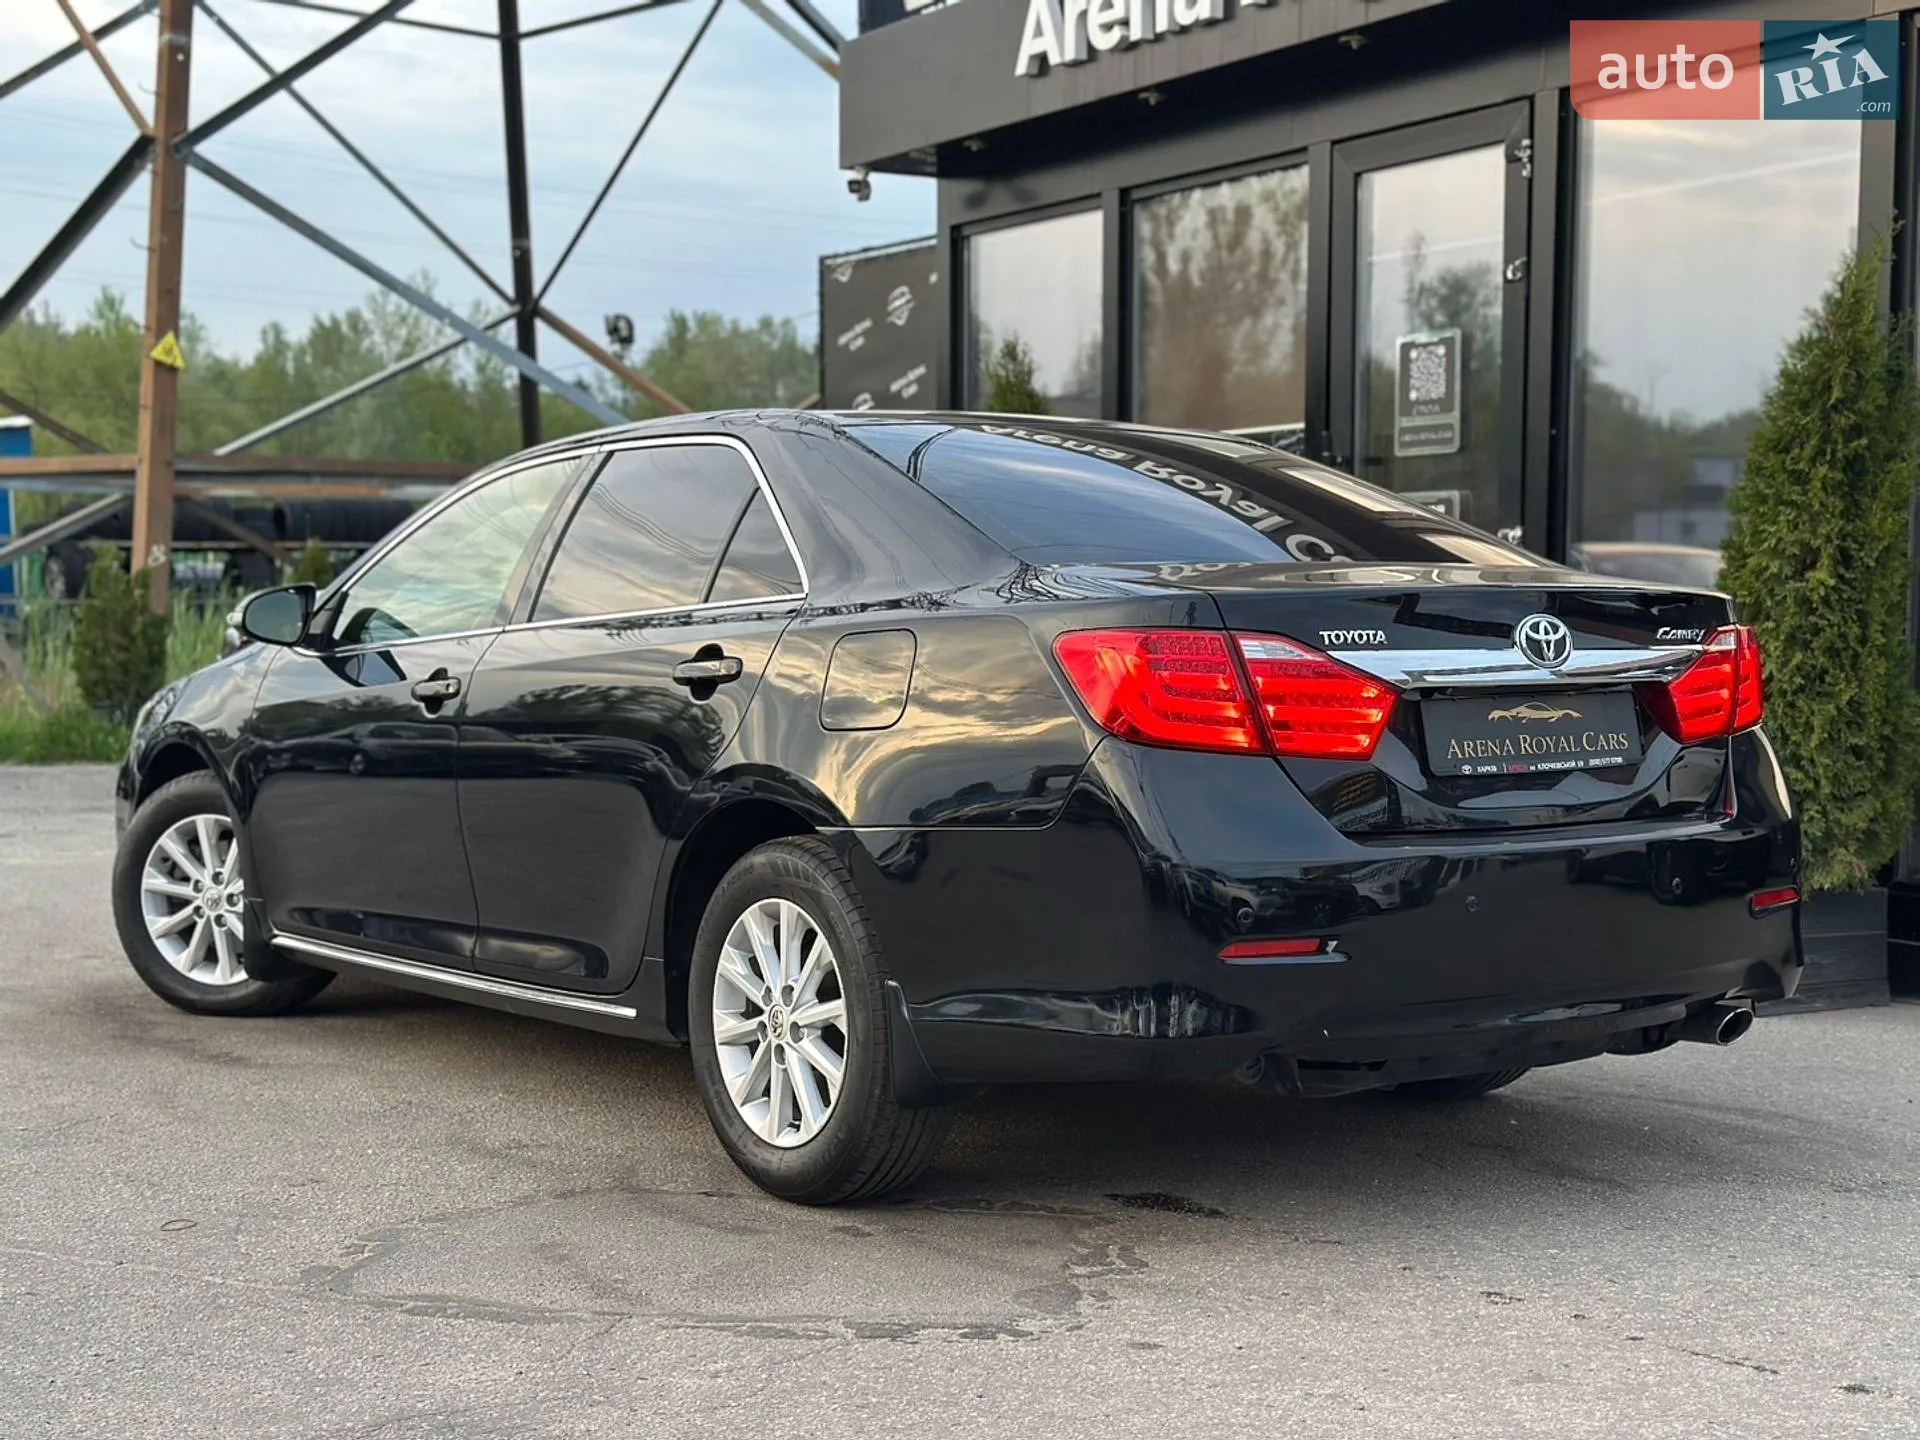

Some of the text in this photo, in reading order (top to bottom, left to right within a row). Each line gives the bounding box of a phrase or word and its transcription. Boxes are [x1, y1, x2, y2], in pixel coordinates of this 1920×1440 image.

[1319, 630, 1388, 645] TOYOTA
[1447, 731, 1629, 759] ARENA ROYAL CARS
